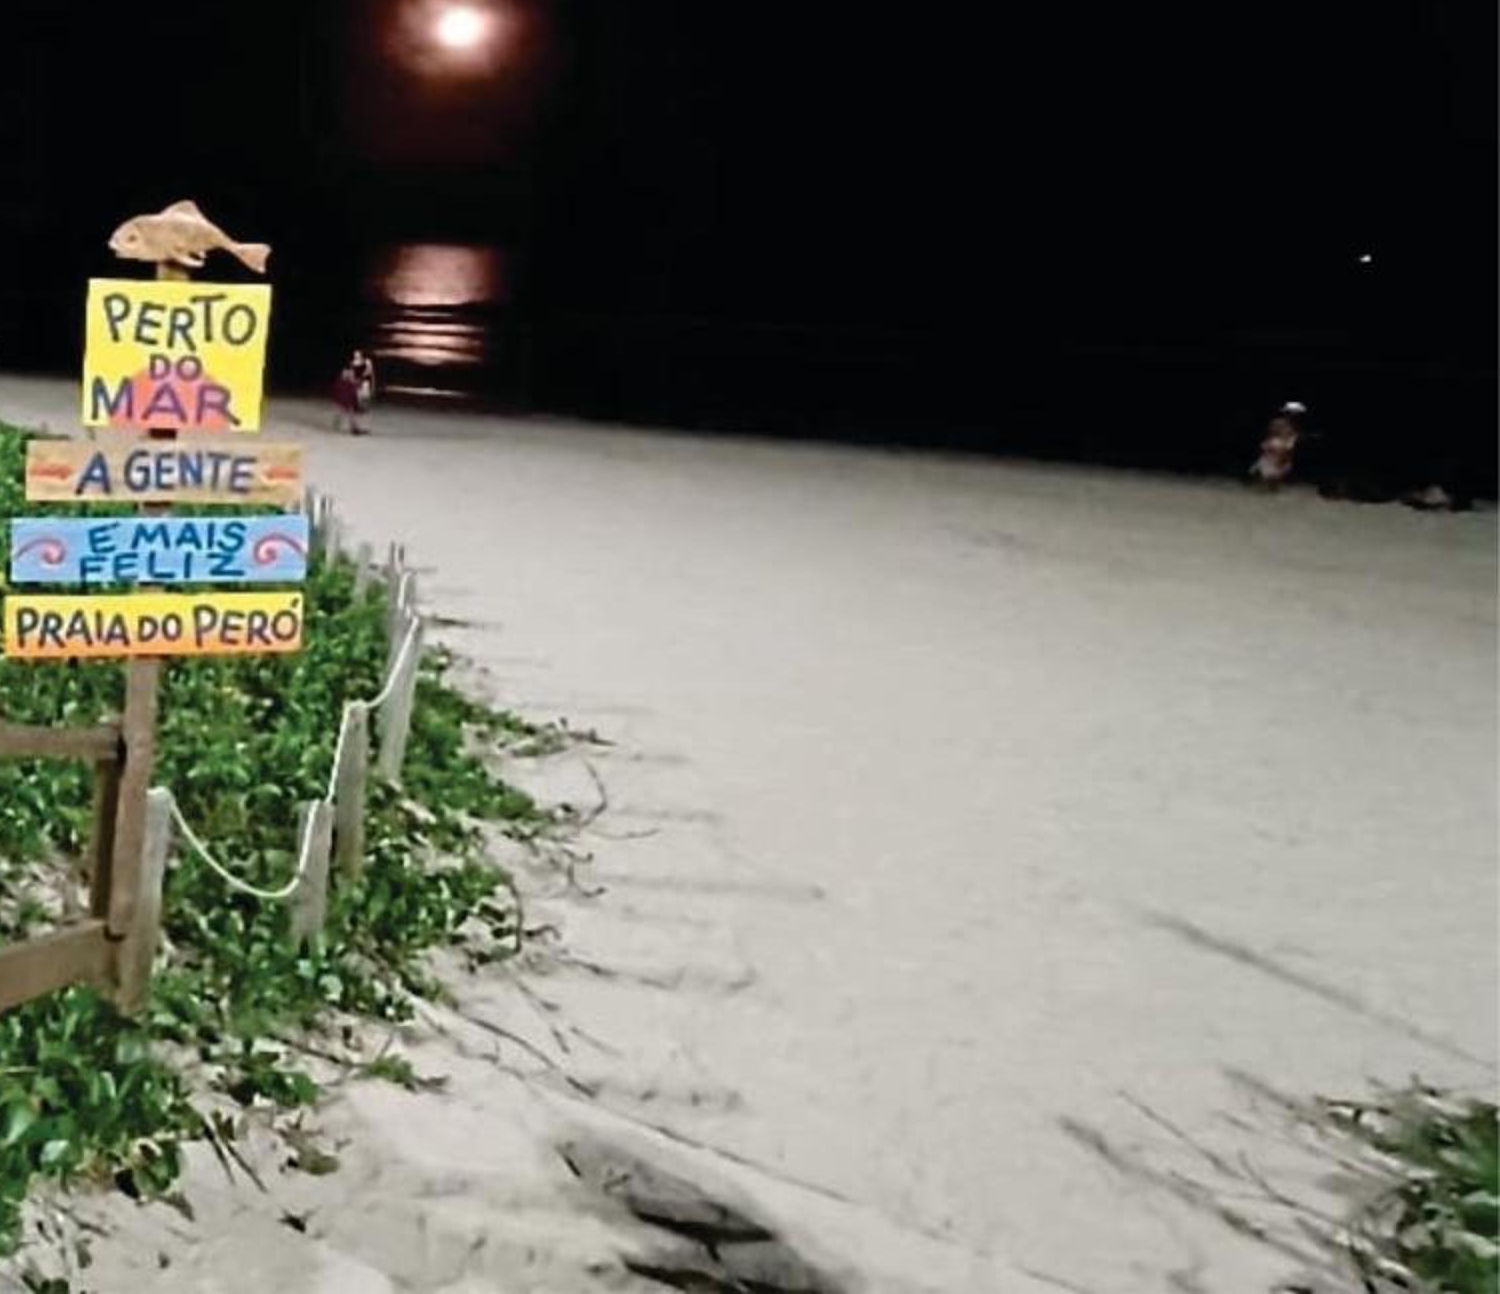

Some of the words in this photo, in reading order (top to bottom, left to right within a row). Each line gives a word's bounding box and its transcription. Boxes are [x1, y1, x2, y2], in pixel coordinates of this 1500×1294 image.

[104, 293, 256, 351] PERTO
[150, 354, 202, 381] DO
[91, 376, 240, 425] MAR
[76, 452, 111, 494] A
[124, 450, 257, 493] GENTE
[131, 521, 246, 552] MAIS
[80, 552, 245, 585] FELIZ
[16, 607, 130, 648] PRAIA
[138, 614, 182, 642] DO
[193, 598, 299, 646] PERÓ
